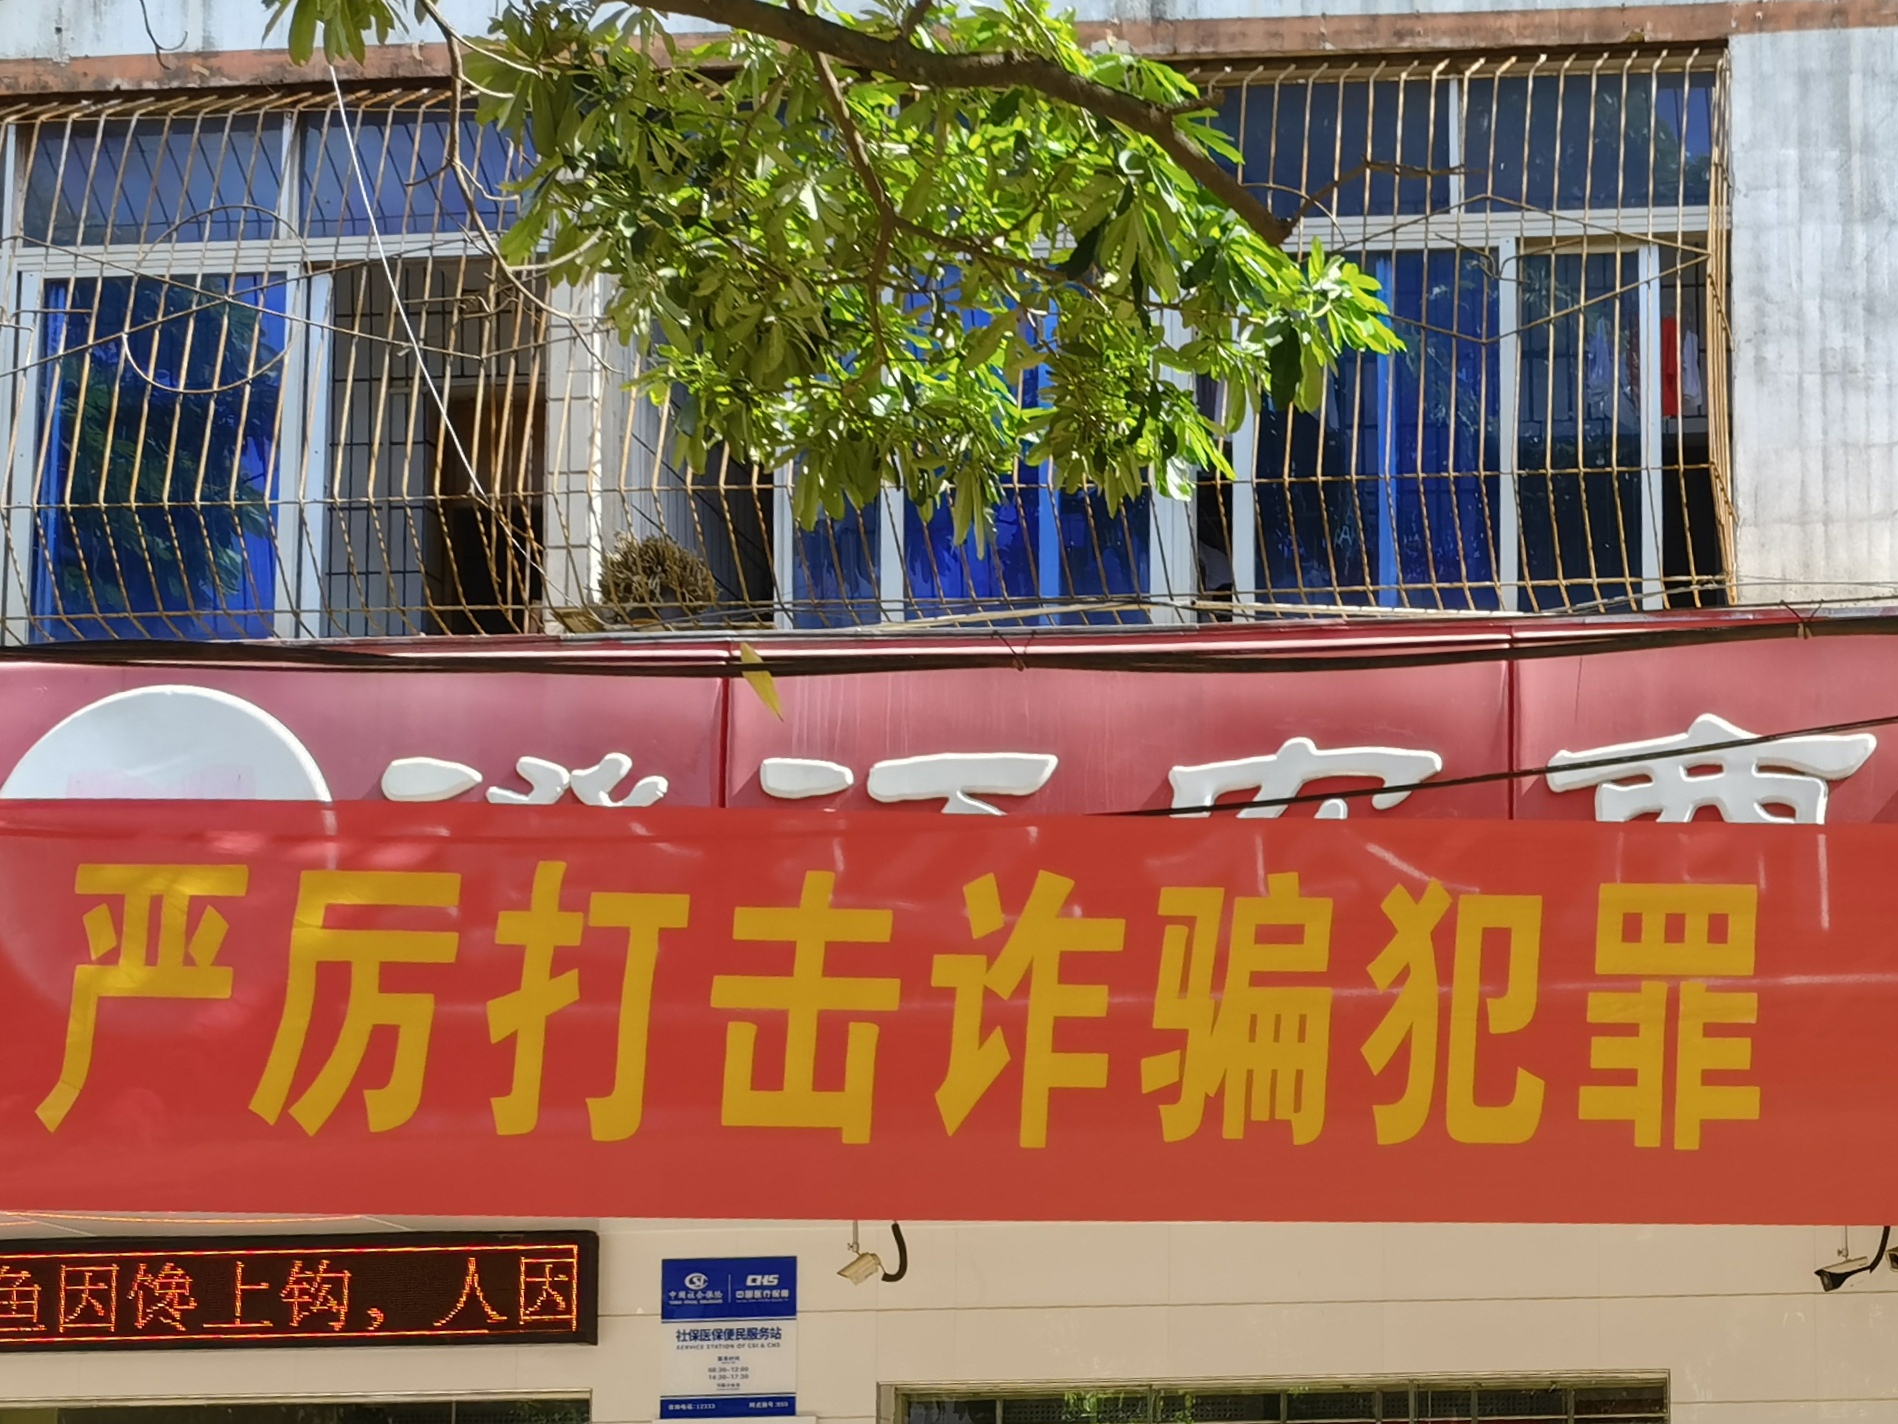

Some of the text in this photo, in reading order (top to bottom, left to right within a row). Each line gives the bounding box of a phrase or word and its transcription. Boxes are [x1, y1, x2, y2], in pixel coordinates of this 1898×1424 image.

[37, 862, 1760, 1150] 严厉打击诈骗犯罪
[746, 1275, 779, 1286] CHS
[676, 1327, 782, 1342] 社保医保便民服务站
